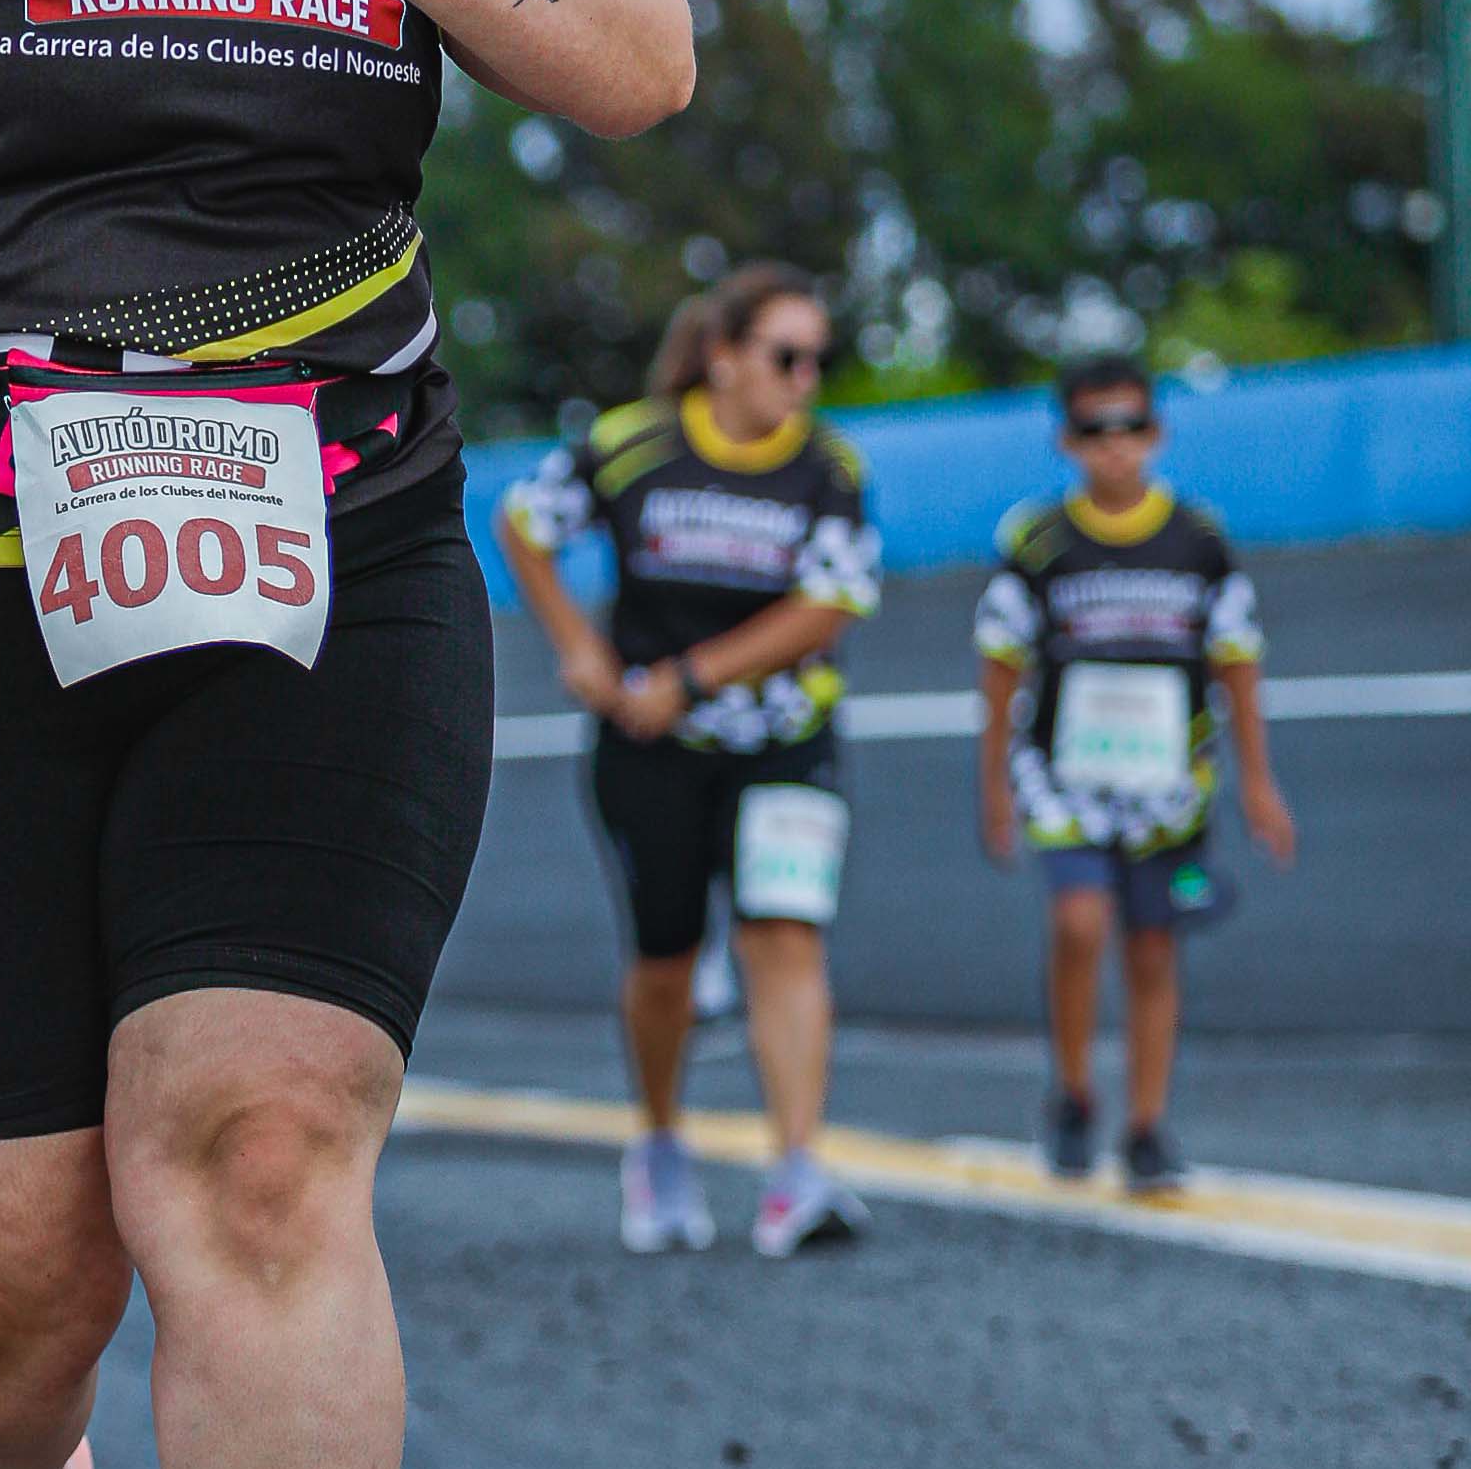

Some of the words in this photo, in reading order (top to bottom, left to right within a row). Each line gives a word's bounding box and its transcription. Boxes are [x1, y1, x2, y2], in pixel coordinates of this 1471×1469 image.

[19, 32, 113, 58] Carrera
[121, 34, 154, 59] de
[162, 34, 199, 61] los
[206, 38, 295, 64] Clubes
[302, 45, 339, 72] del
[346, 50, 421, 84] Noroeste
[50, 407, 279, 467] AUTÓDROMO
[88, 455, 183, 484] RUNNING
[189, 457, 244, 482] RACE
[55, 502, 69, 514] La
[70, 491, 116, 509] Carrera
[119, 487, 136, 499] de
[139, 486, 158, 497] los
[161, 485, 203, 498] Clubes
[206, 488, 226, 500] del
[229, 489, 284, 507] Noroeste
[39, 517, 316, 625] 4005
